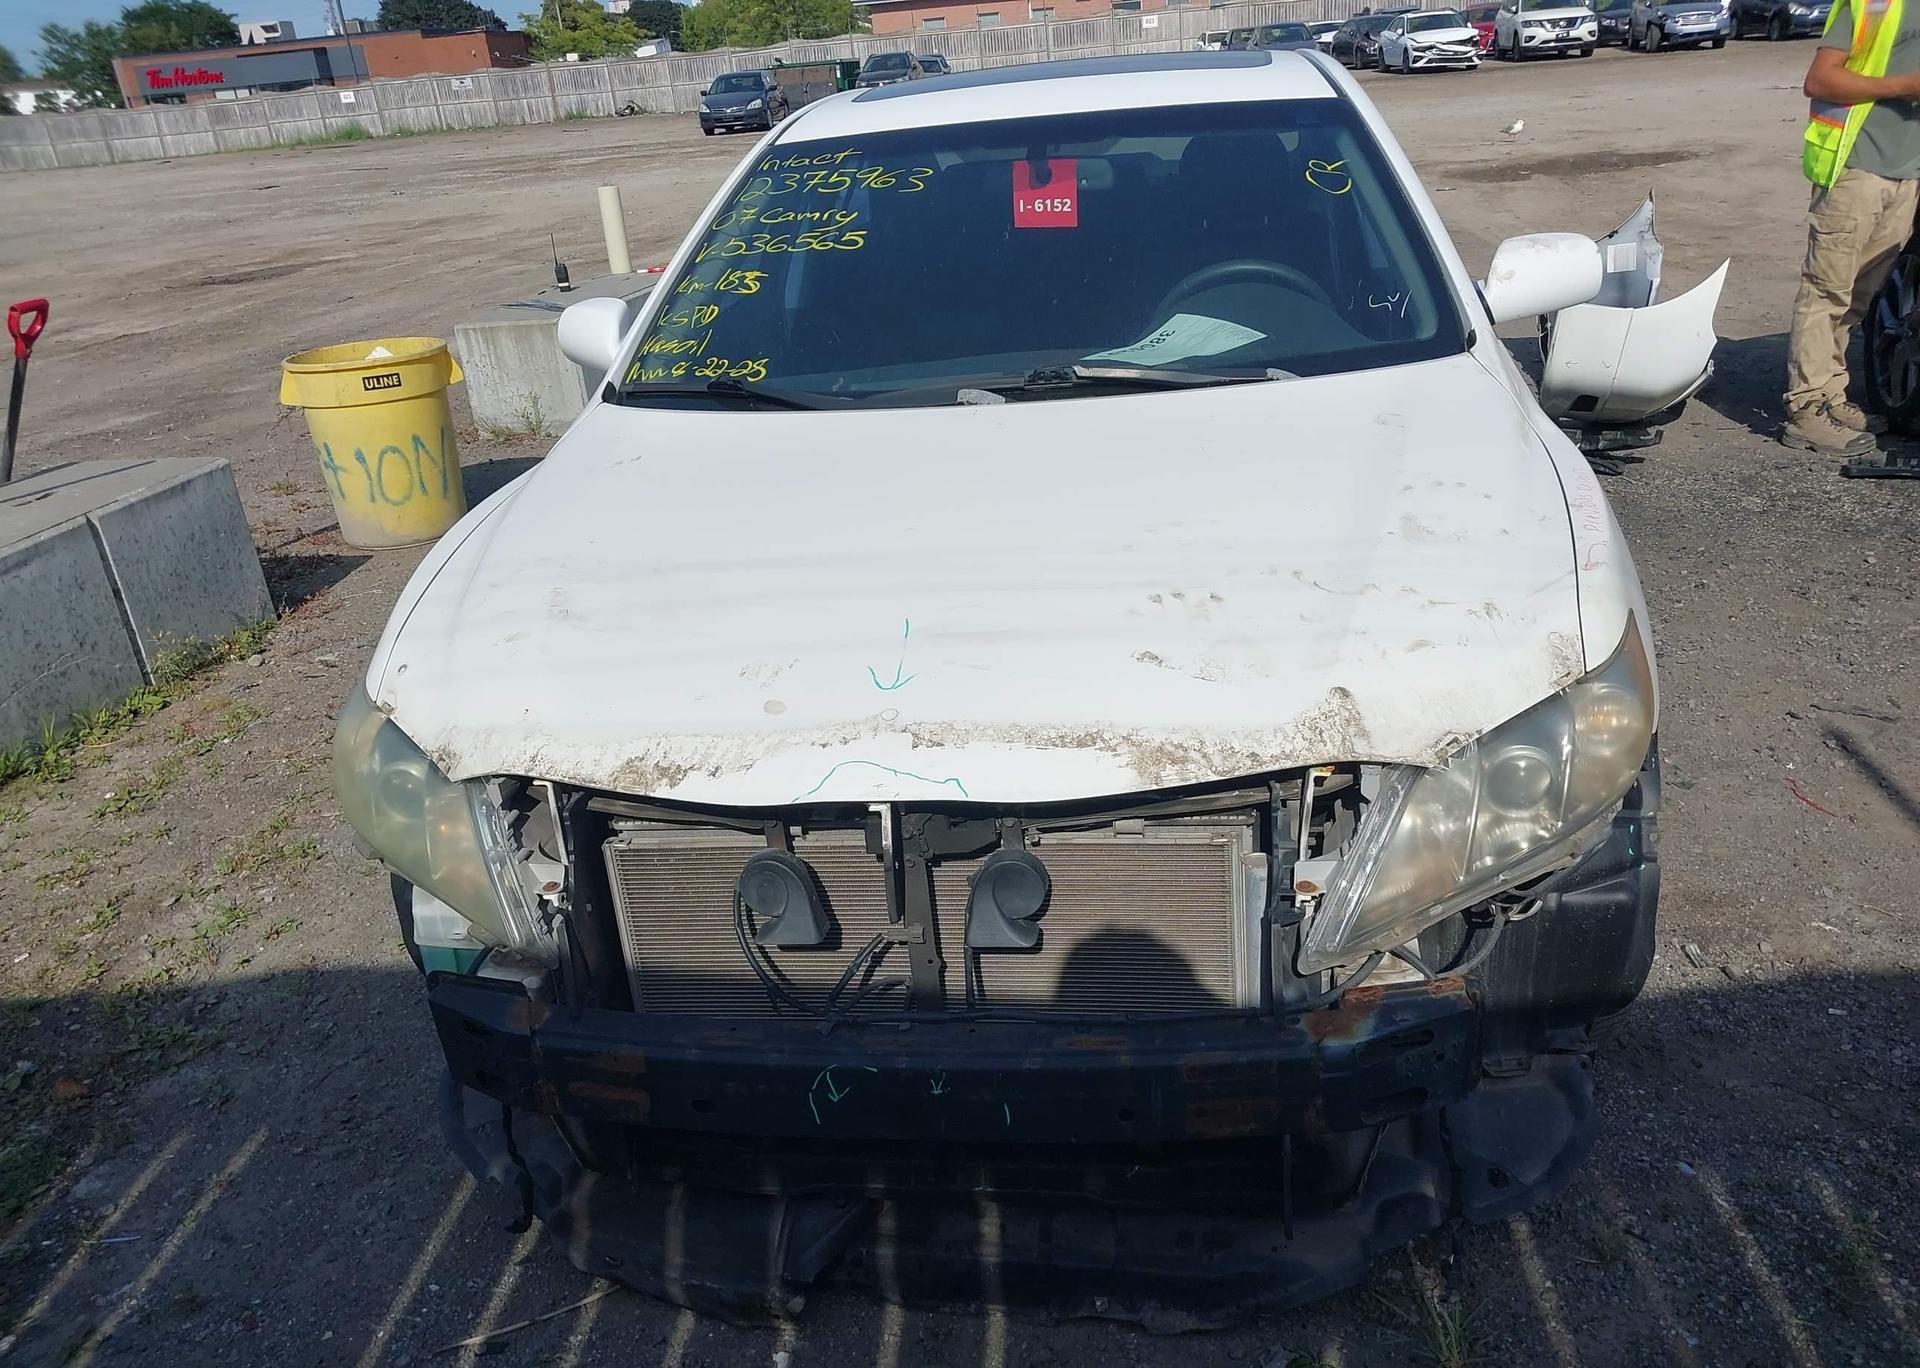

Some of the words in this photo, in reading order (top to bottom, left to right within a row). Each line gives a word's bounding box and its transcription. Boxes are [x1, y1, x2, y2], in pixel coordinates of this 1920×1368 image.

[147, 69, 173, 89] Tim
[1019, 198, 1072, 213] I-6152
[364, 375, 400, 390] ULINE
